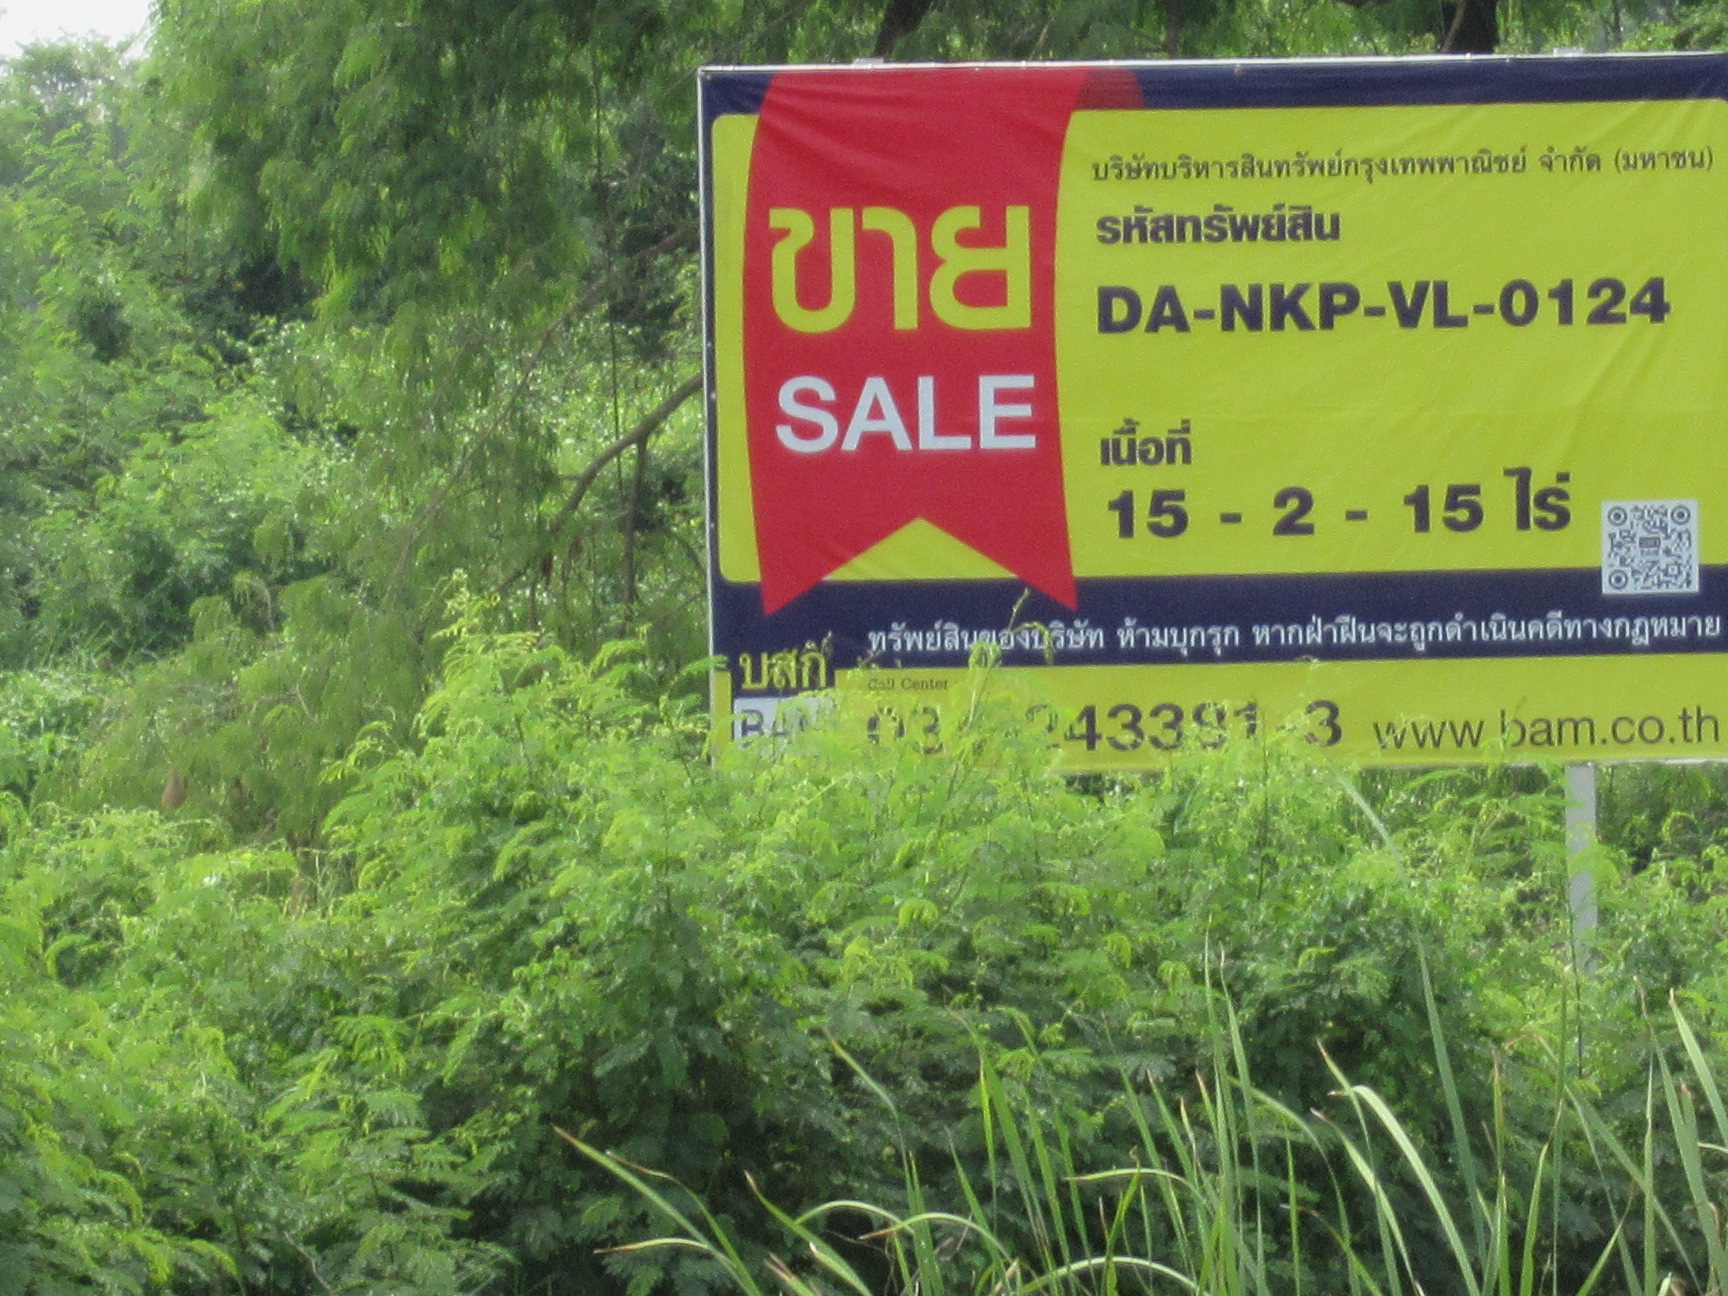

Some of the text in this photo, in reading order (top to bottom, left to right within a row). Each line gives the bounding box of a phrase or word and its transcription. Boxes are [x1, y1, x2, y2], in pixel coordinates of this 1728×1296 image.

[1092, 145, 1714, 185] บริษัทบริหารสินทรัพย์กรุงเทพพาณิชย์ จำกัด (มหาชน)
[1096, 203, 1341, 245] รหัสทรัพย์สิน
[768, 205, 1032, 334] ขาย
[1096, 276, 1671, 335] DA-NKP-VL-0124
[775, 373, 1037, 454] SALE
[1100, 417, 1193, 466] เนื้อที่
[1107, 488, 1190, 539] 15
[1272, 487, 1316, 536] 2
[1404, 483, 1485, 533] 15
[1504, 466, 1572, 532] ไร่
[868, 609, 1722, 657] ทรัพย์สินของบริษัท ห้ามบุกรุก หากฝ่าฝืนจะถูกดำเนินคดีทางกฎหมาย
[900, 676, 950, 692] Center
[1373, 705, 1720, 752] wwwbam.co.th
